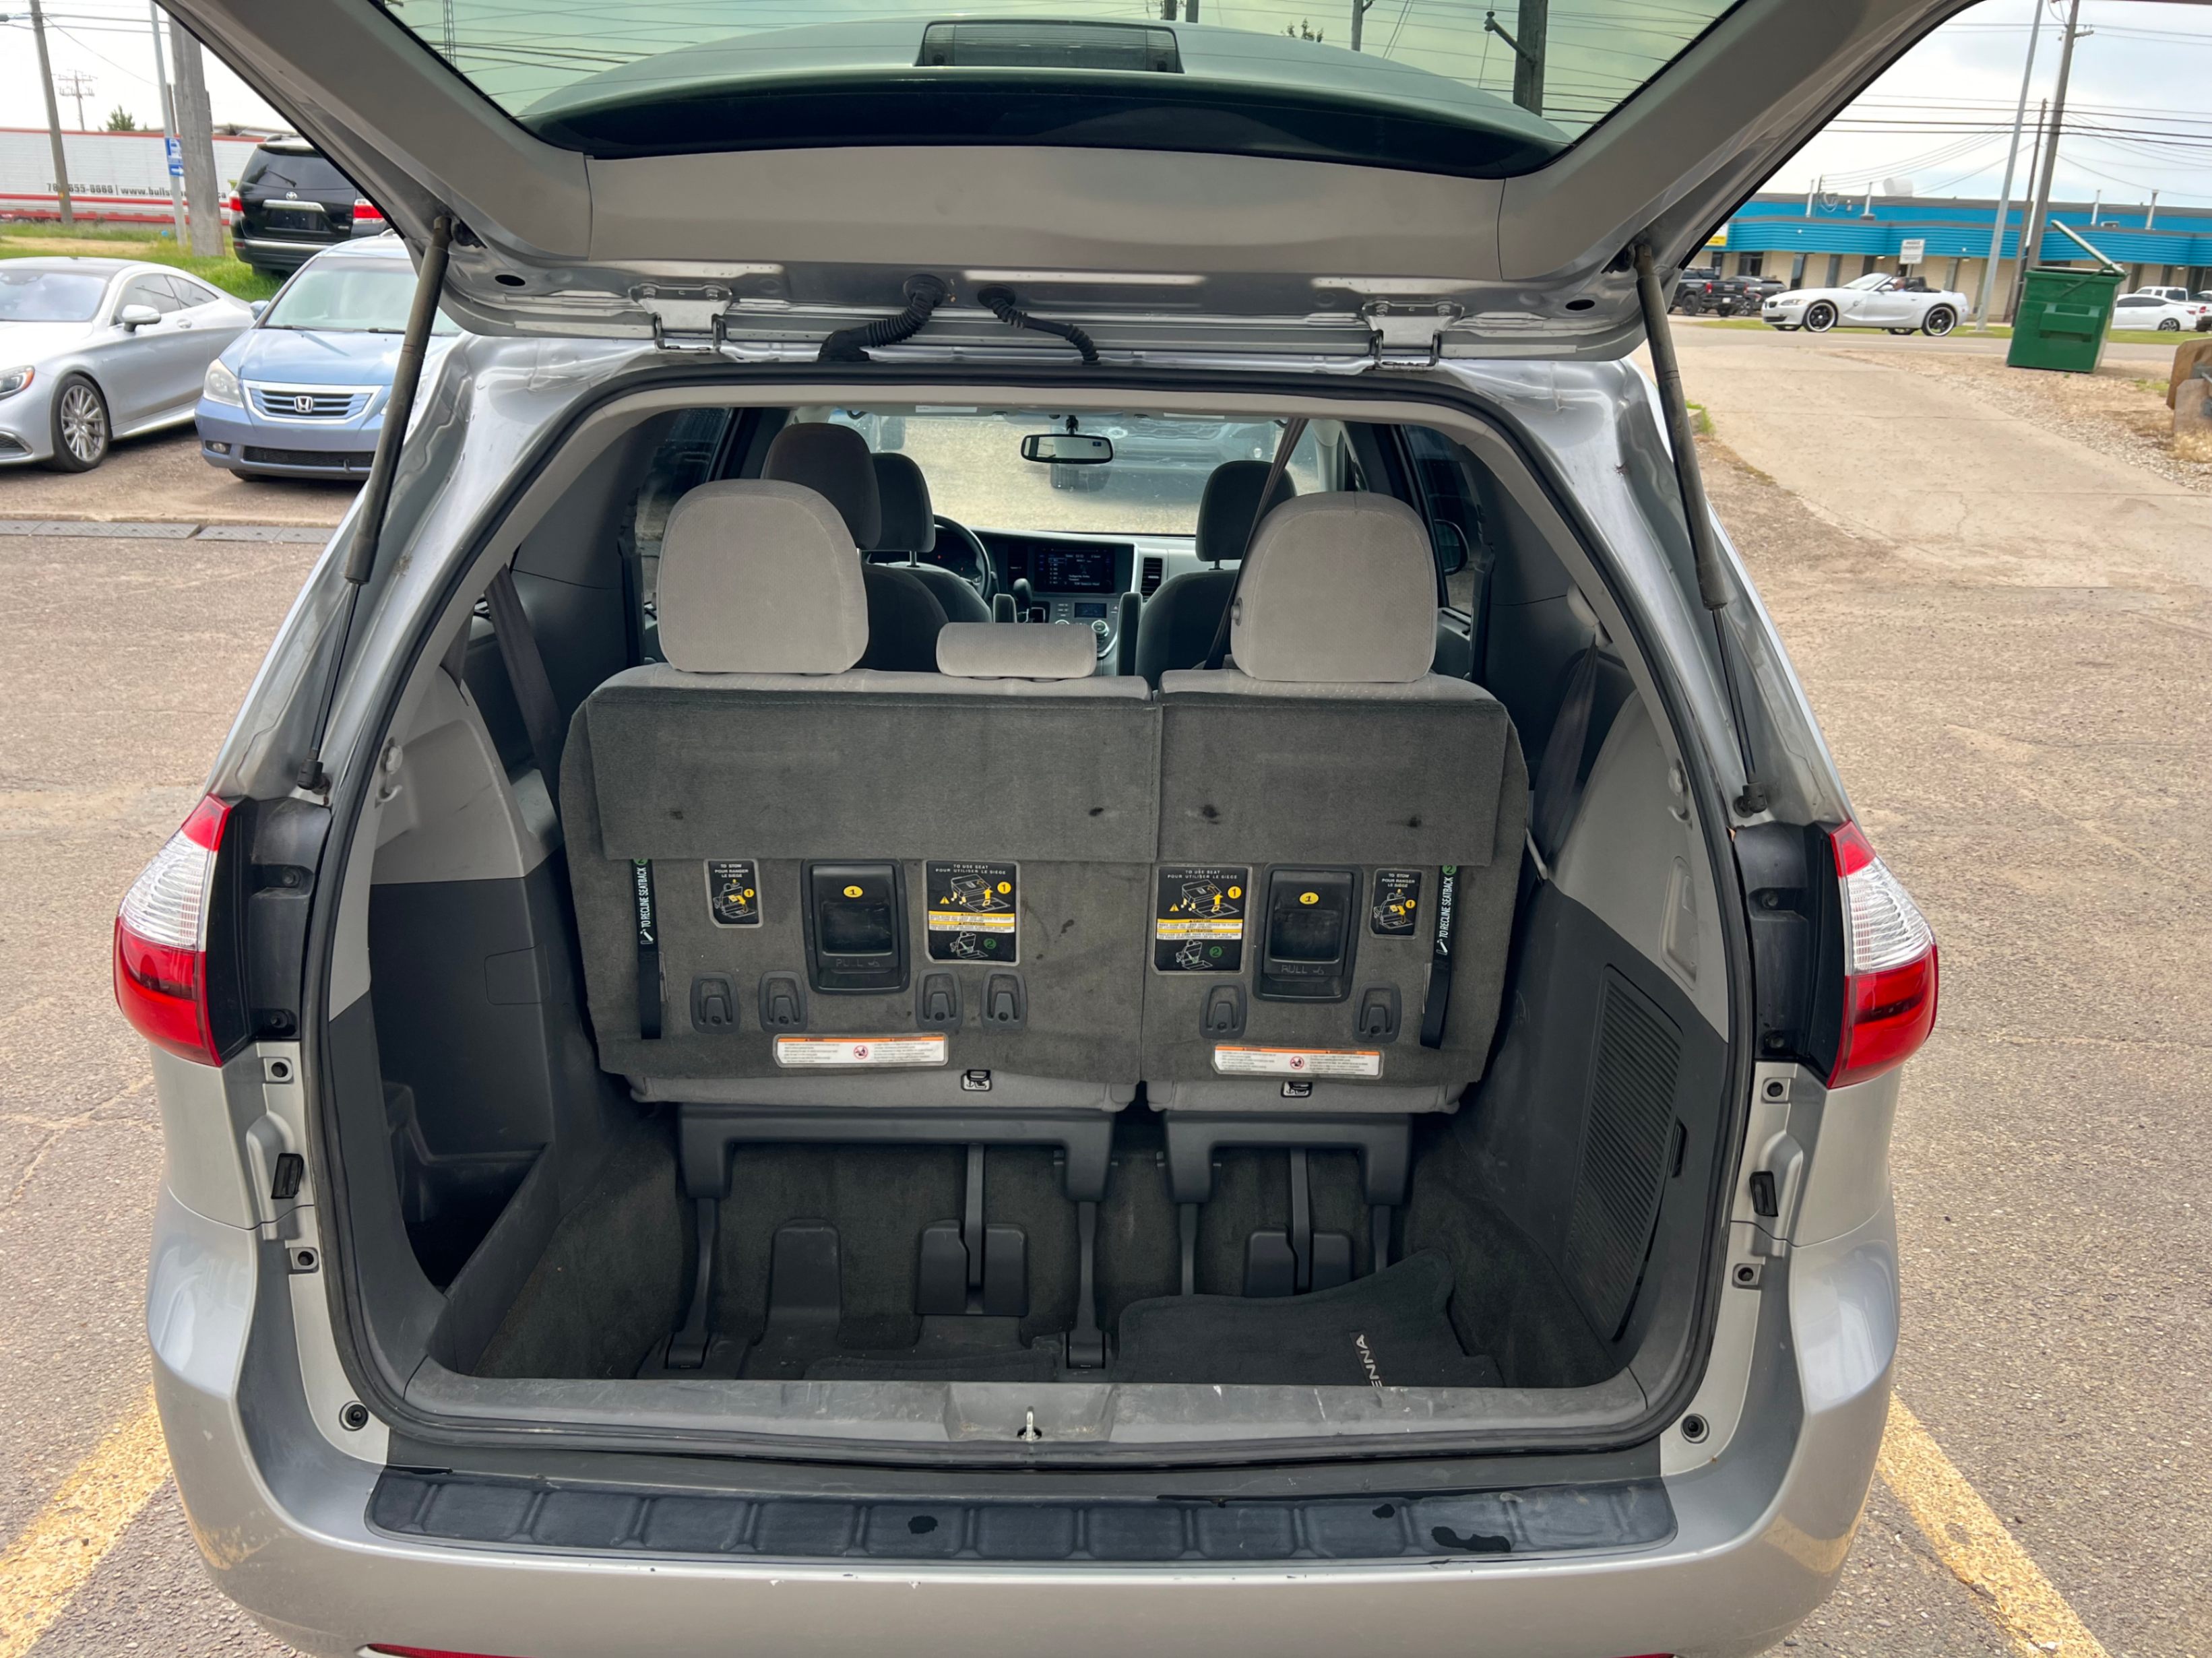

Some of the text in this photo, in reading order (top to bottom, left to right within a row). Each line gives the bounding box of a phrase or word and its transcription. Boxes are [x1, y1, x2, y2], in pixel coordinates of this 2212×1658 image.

[637, 867, 648, 896] SEATBACK
[1442, 876, 1453, 905] SEATBACK
[639, 897, 650, 920] RECLINE
[1440, 906, 1451, 930] RECLINE
[1282, 965, 1307, 974] PULL
